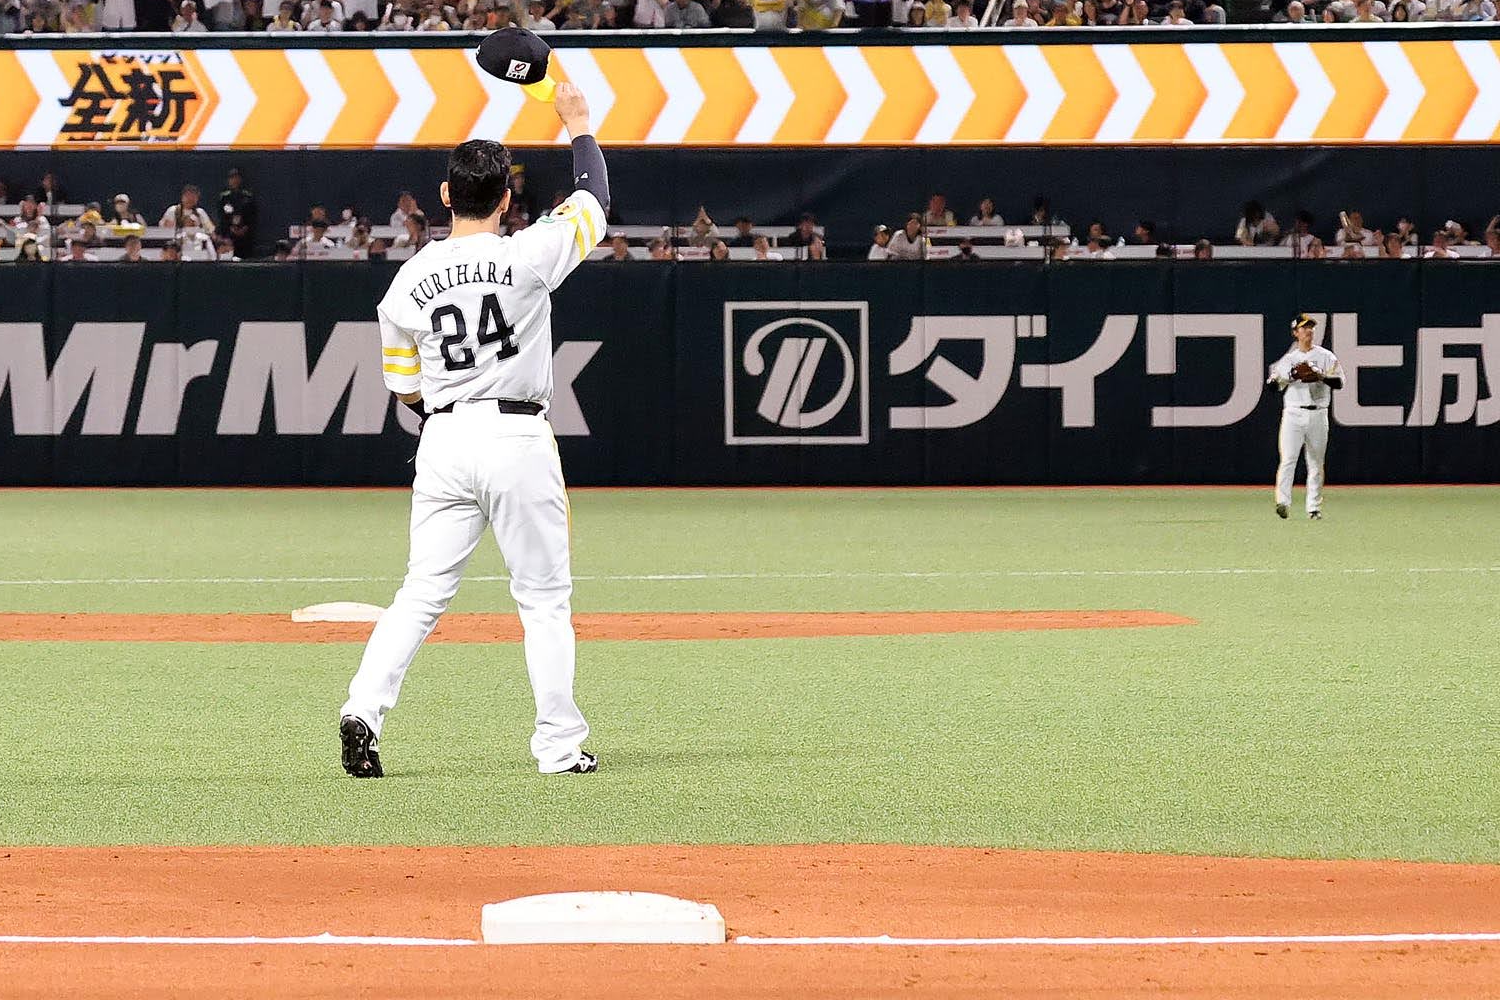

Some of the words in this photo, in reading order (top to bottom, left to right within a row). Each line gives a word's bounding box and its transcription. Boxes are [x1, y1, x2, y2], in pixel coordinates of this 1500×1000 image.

[58, 63, 197, 132] 全新
[410, 261, 514, 310] KURIHARA
[430, 292, 520, 372] 24
